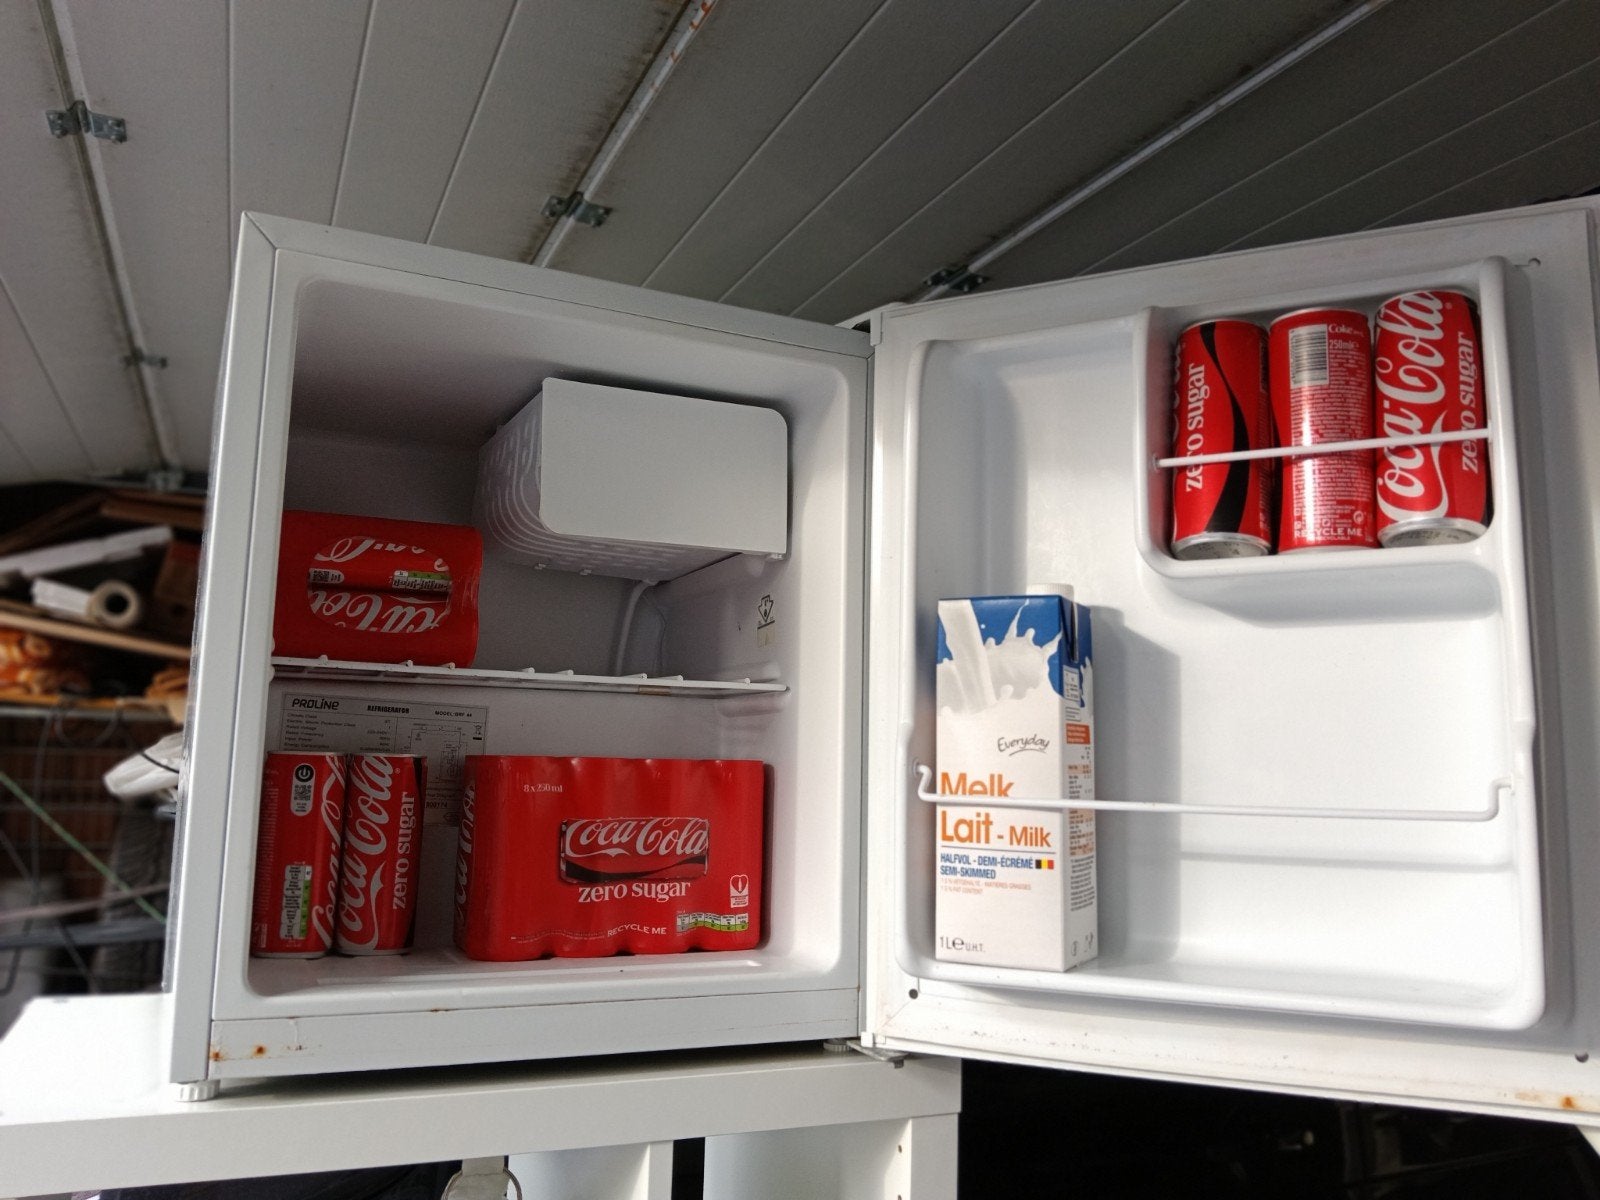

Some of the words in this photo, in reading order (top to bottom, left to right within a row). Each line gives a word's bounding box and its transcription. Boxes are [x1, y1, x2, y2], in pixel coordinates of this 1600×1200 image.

[1458, 331, 1478, 408] sugar
[1187, 363, 1210, 429] sugar
[1375, 291, 1448, 521] Coca-Cola
[1347, 528, 1362, 536] ME
[367, 704, 410, 715] REFRIGERATOR
[997, 734, 1050, 752] Everyday
[941, 772, 1015, 798] Melk
[397, 791, 416, 854] sugar
[941, 810, 993, 844] Lait
[1009, 825, 1052, 847] Milk
[564, 816, 709, 858] Coca-Cola
[940, 853, 972, 866] HALFVOL
[977, 855, 1034, 869] DEMI-ÉCRÉMÉ
[940, 865, 996, 880] SEMI-SKIMMED
[393, 858, 410, 910] zero
[578, 883, 628, 903] zero
[631, 880, 691, 902] sugar
[607, 922, 650, 938] RECYCLE
[651, 926, 667, 936] ME
